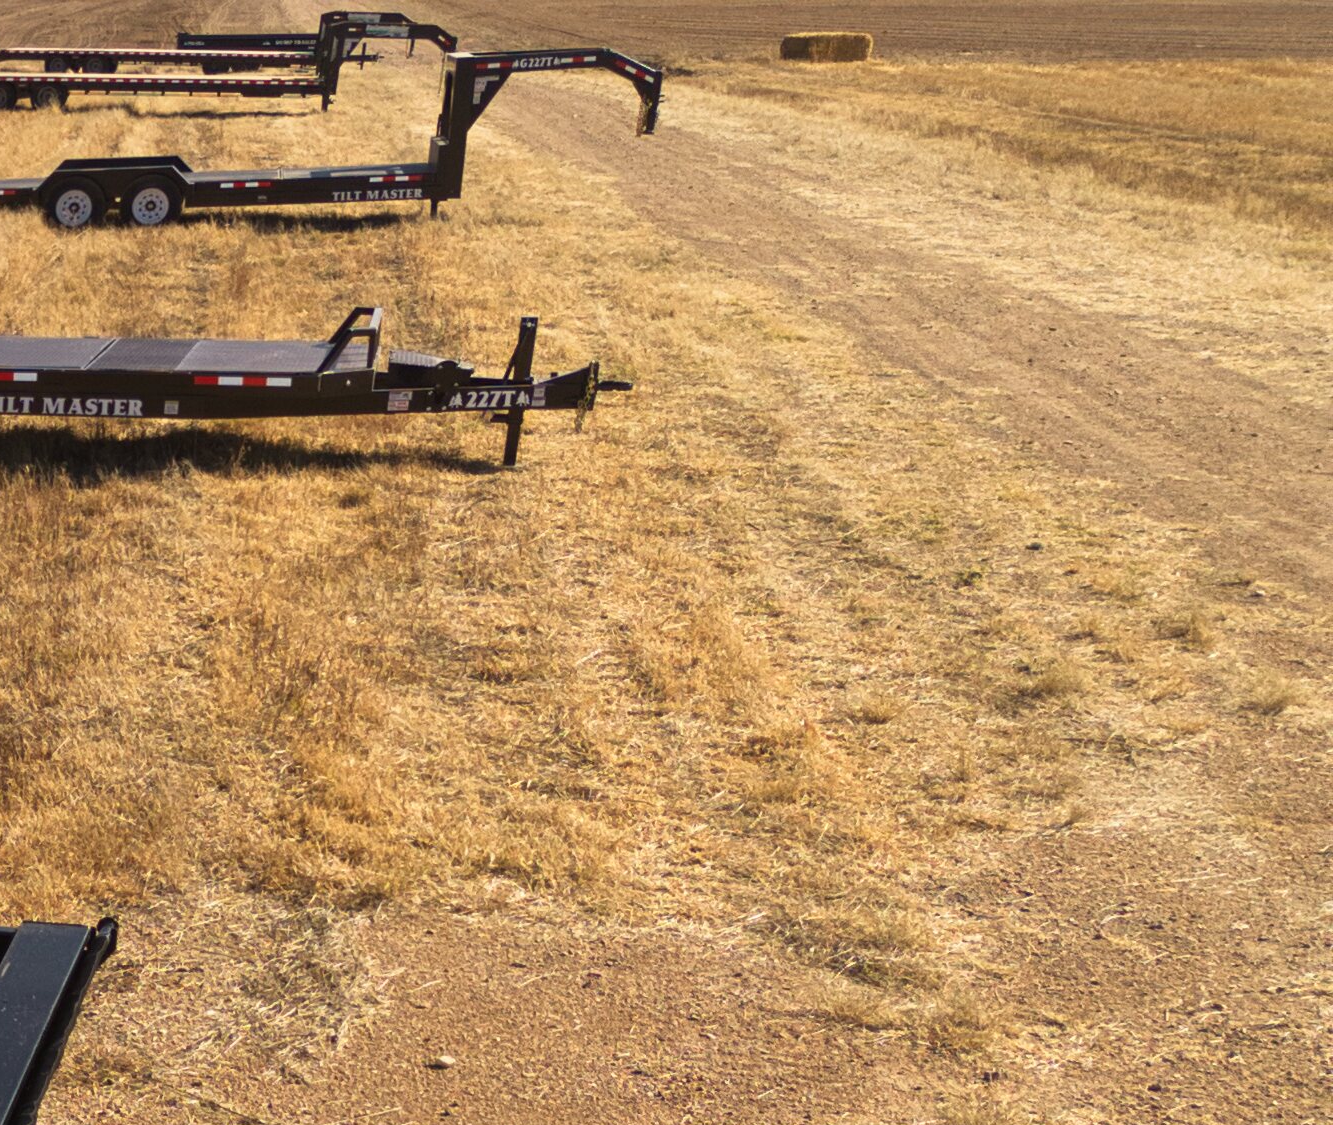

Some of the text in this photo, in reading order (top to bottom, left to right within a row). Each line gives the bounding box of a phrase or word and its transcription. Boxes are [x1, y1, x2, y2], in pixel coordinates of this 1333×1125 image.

[520, 56, 554, 69] G227T
[333, 188, 423, 201] TILT MASTER
[41, 397, 144, 417] MASTER
[465, 390, 517, 409] 227T
